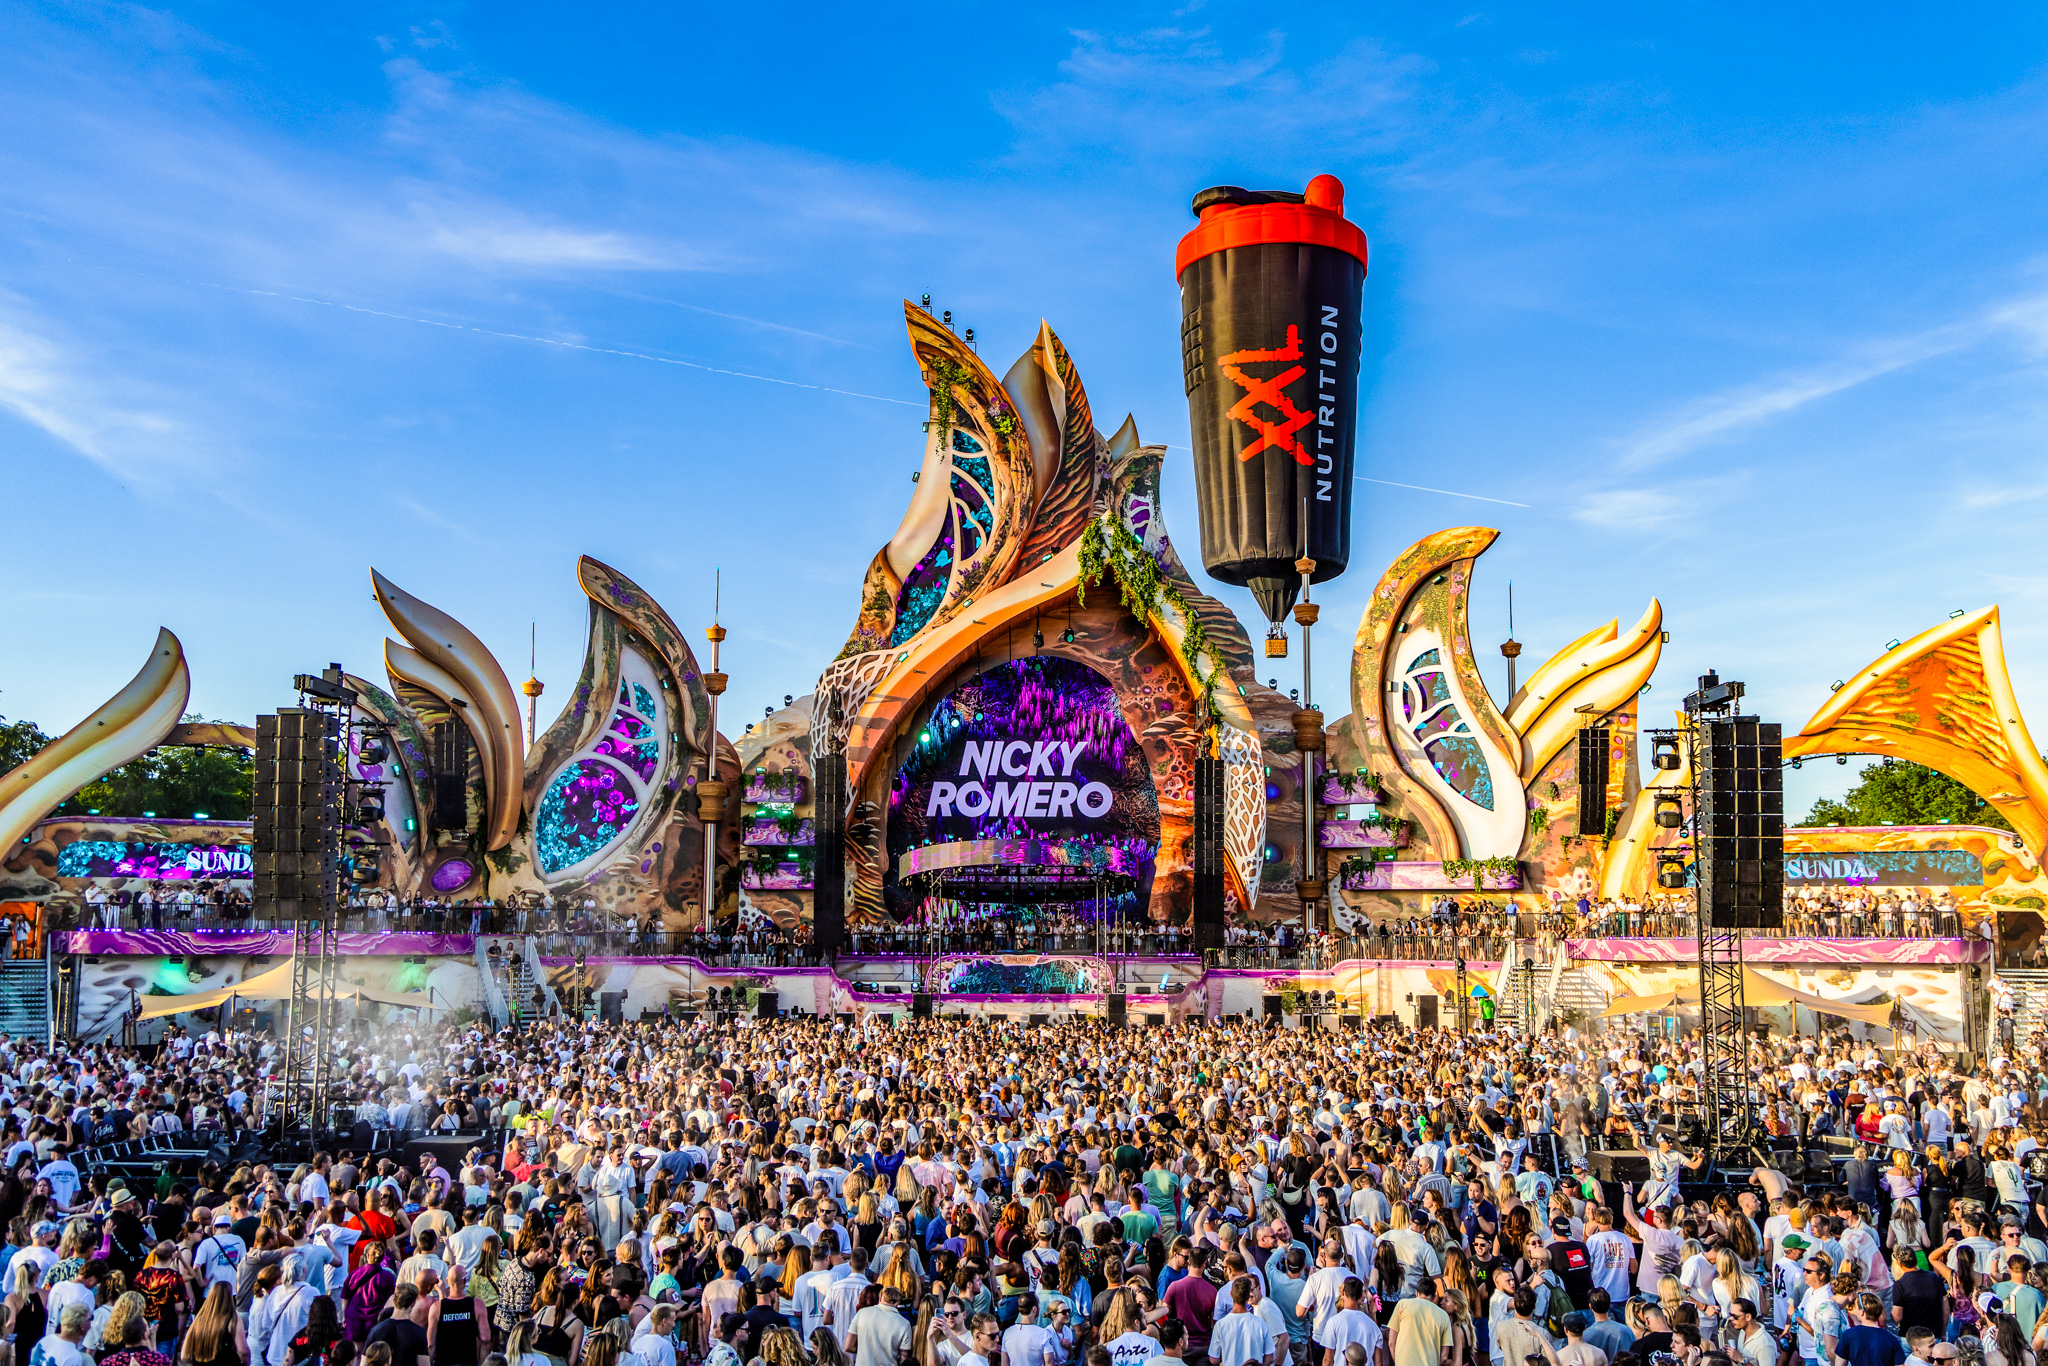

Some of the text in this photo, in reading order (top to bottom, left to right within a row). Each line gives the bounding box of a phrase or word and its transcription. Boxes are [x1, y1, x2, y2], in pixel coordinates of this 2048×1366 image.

[1218, 324, 1316, 466] XXL
[1316, 304, 1339, 501] NUTRITION
[958, 740, 1088, 782] NICKY
[926, 781, 1113, 818] ROMERO
[185, 851, 254, 872] SUND
[1114, 1344, 1149, 1359] Arte
